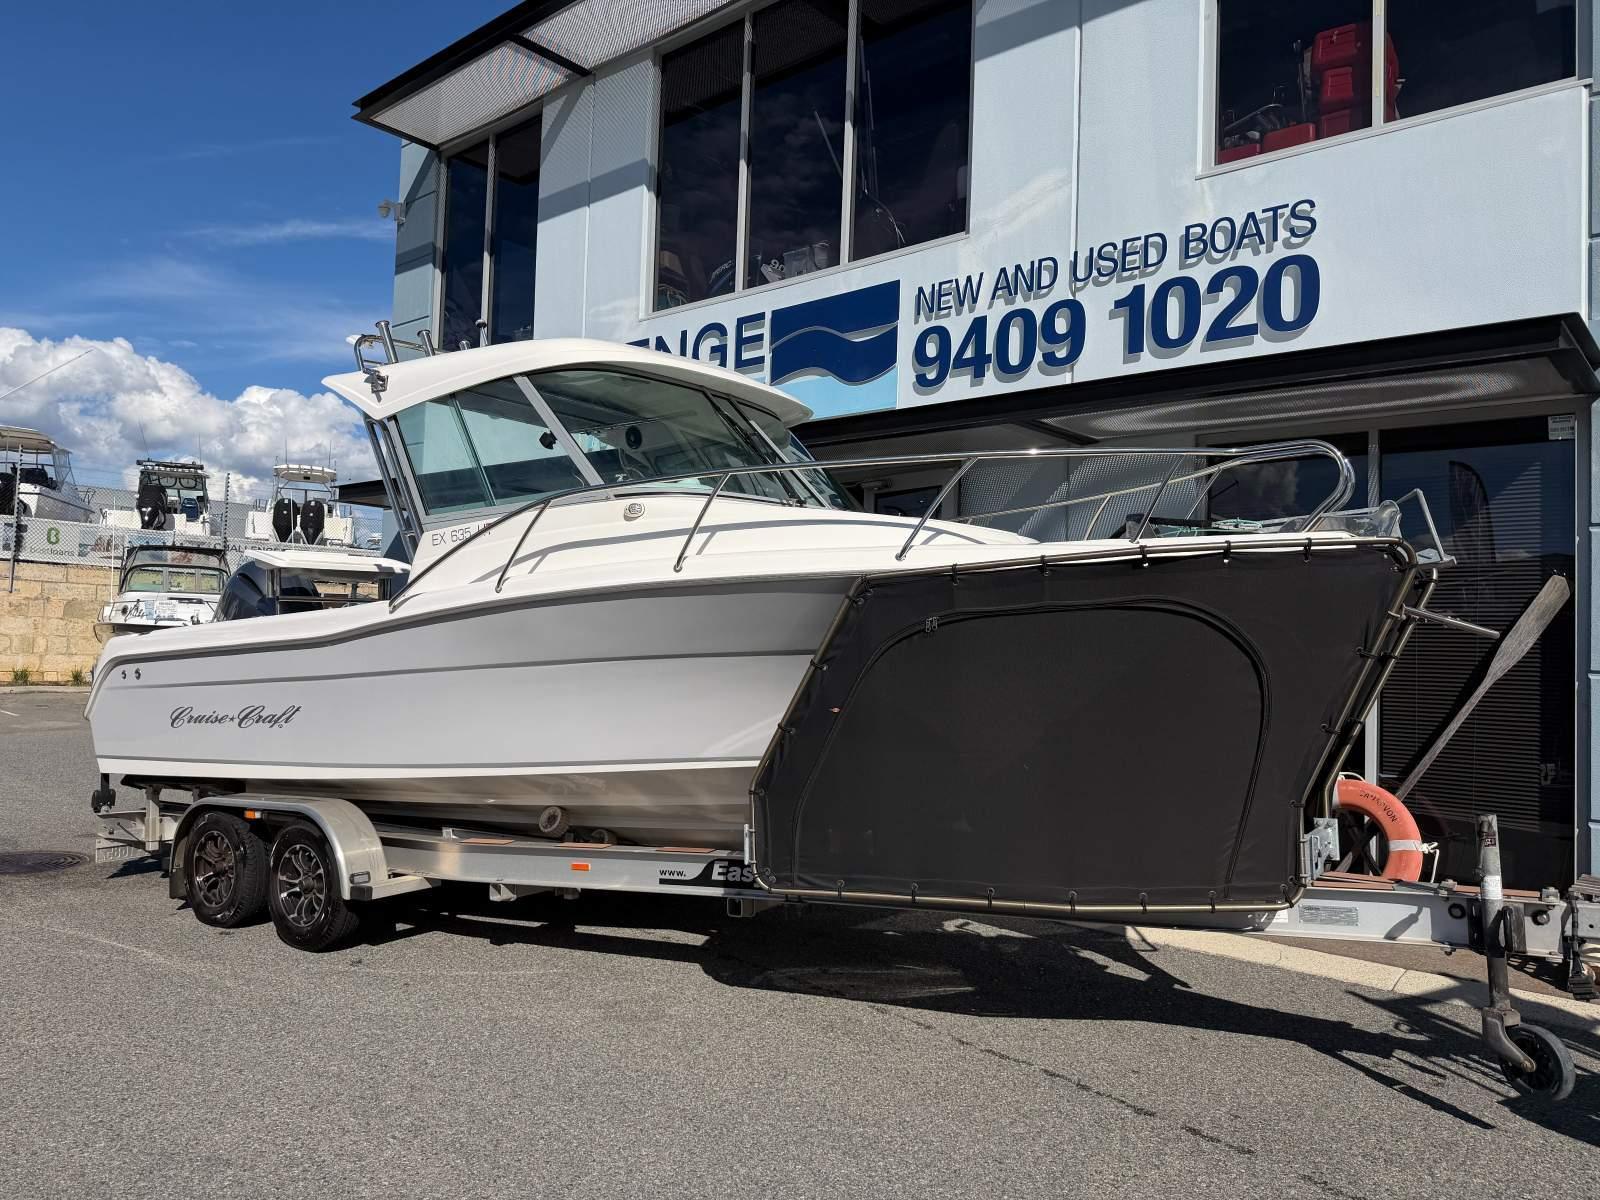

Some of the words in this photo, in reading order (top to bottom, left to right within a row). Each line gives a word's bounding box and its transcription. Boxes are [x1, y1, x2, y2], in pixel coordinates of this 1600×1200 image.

[916, 271, 984, 316] NEW
[990, 256, 1059, 301] AND
[1072, 232, 1168, 283] USED
[1184, 199, 1317, 260] BOATS
[625, 311, 767, 369] NGE
[913, 298, 1087, 389] 9409
[1113, 254, 1321, 355] 1020
[431, 532, 447, 547] EX
[451, 527, 472, 543] 635
[169, 706, 229, 728] Cruise
[237, 704, 302, 728] Craft
[659, 869, 687, 877] www.
